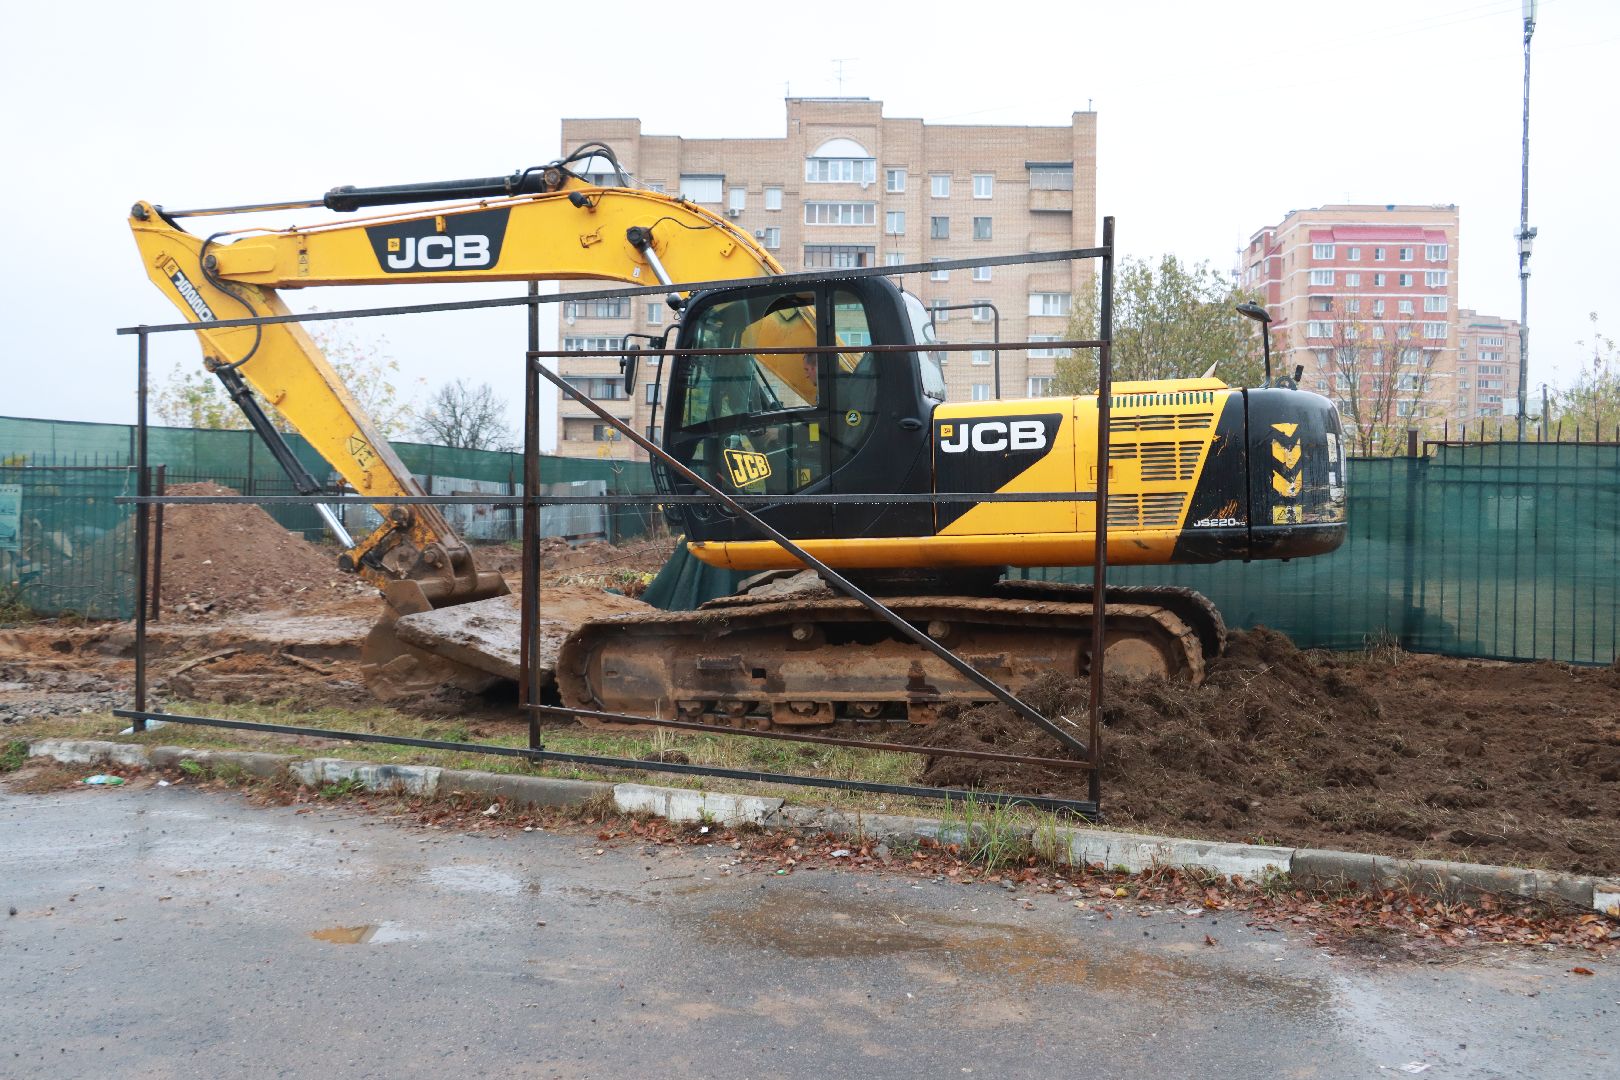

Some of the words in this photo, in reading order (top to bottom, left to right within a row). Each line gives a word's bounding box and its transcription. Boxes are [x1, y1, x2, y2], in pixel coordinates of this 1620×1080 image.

[387, 234, 491, 269] JCB
[940, 420, 1047, 453] JCB
[731, 453, 768, 483] JCB
